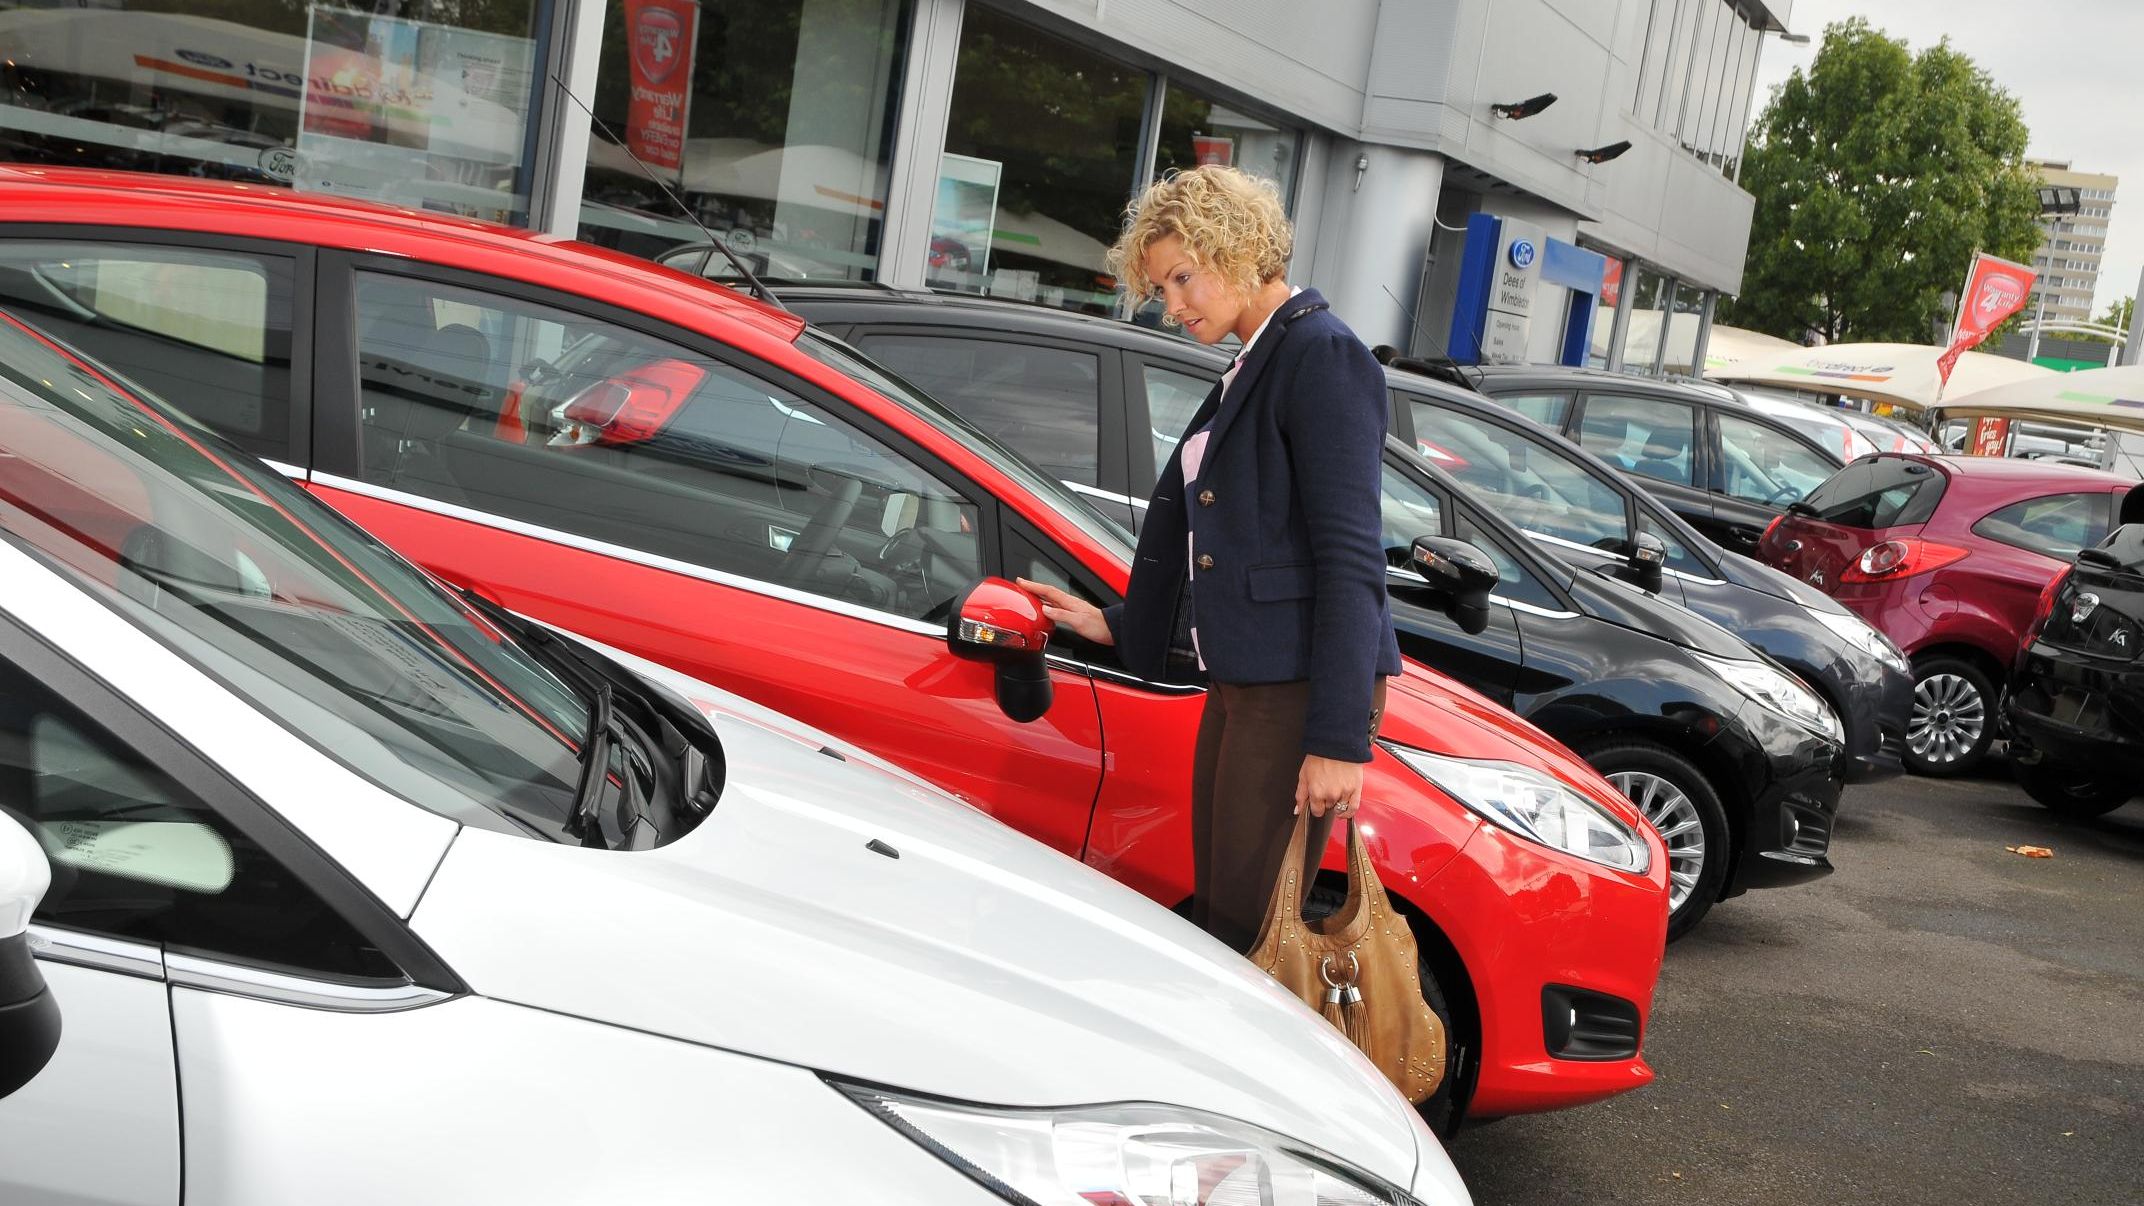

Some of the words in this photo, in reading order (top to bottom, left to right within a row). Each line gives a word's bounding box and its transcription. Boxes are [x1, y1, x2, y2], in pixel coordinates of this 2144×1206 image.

[1503, 272, 1519, 289] Dees
[1983, 282, 2021, 301] Warranty
[1980, 291, 2001, 313] 4
